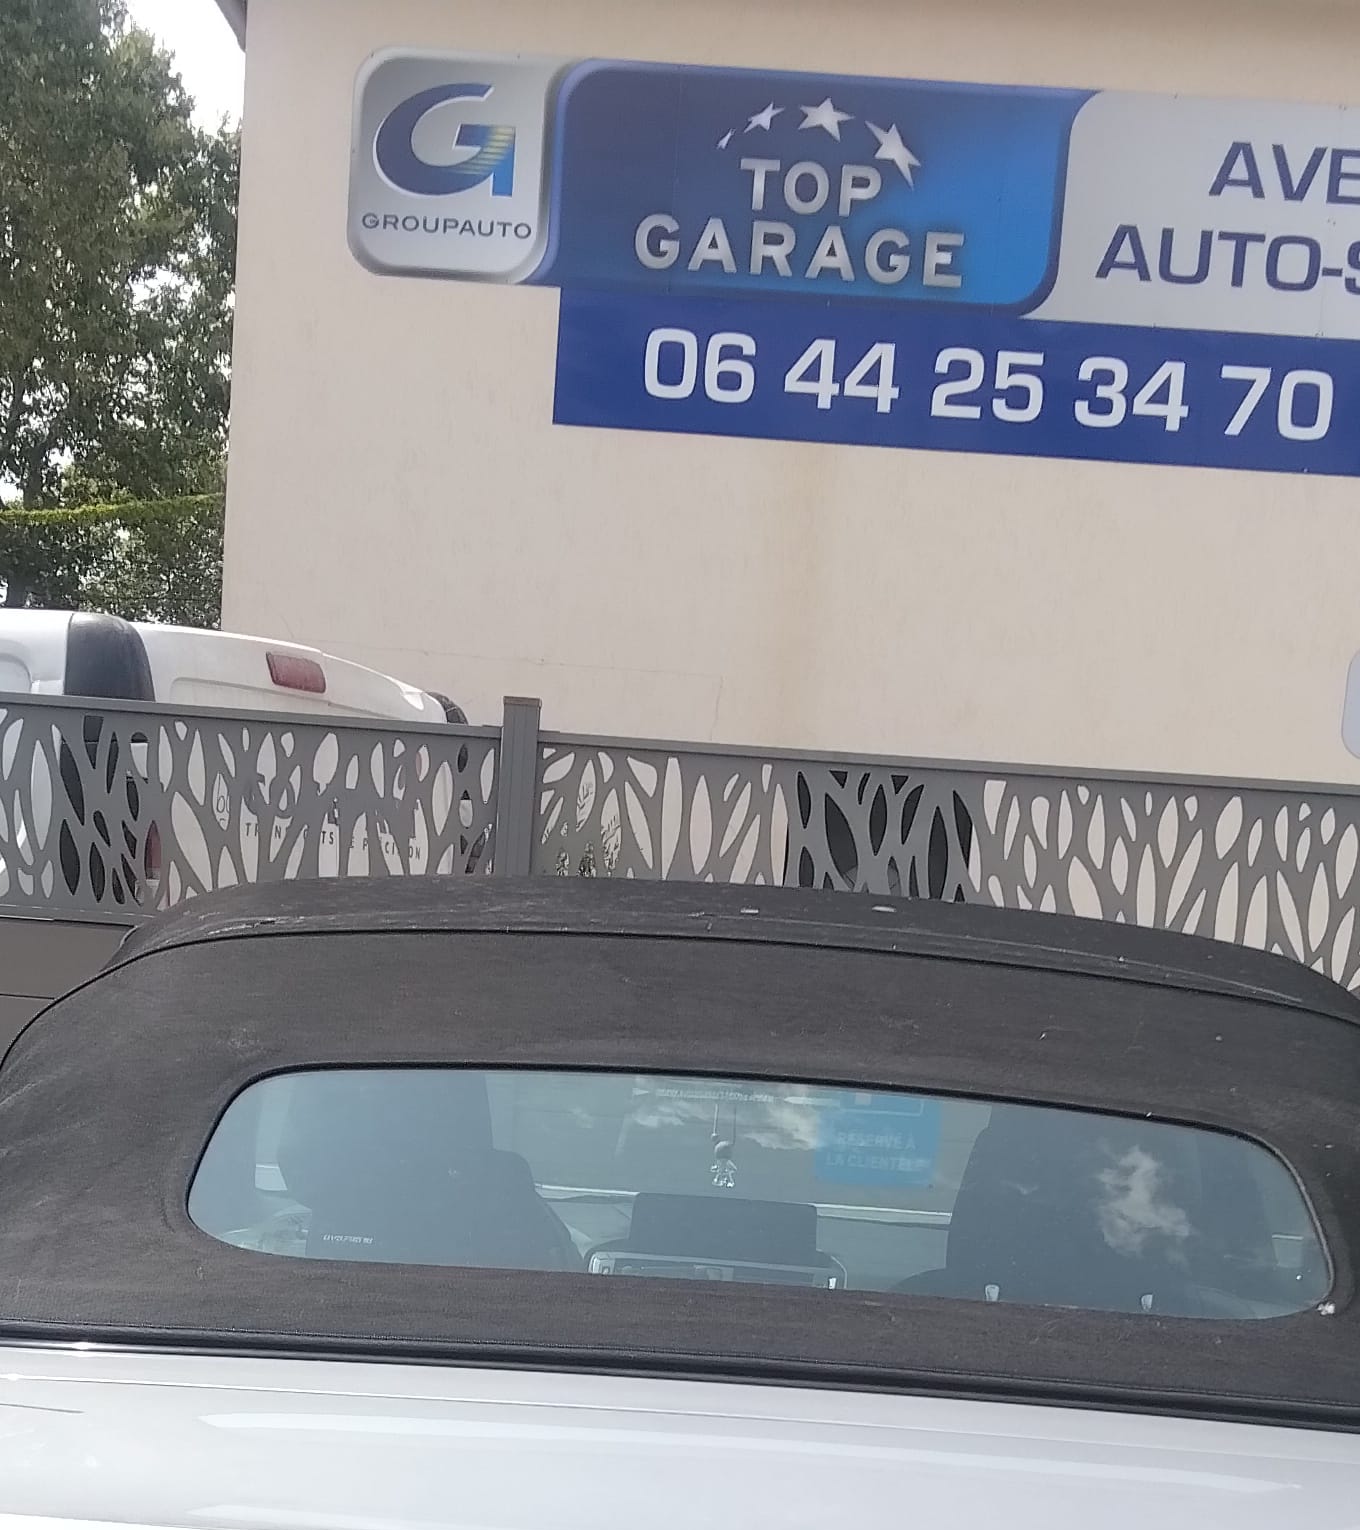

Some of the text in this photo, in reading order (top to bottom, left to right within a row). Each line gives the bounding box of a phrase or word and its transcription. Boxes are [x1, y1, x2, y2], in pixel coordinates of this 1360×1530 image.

[740, 157, 883, 217] TOP
[361, 212, 532, 240] GROUPAUTO
[634, 213, 965, 288] GARAGE
[644, 328, 1335, 441] 06 44 25 34 70
